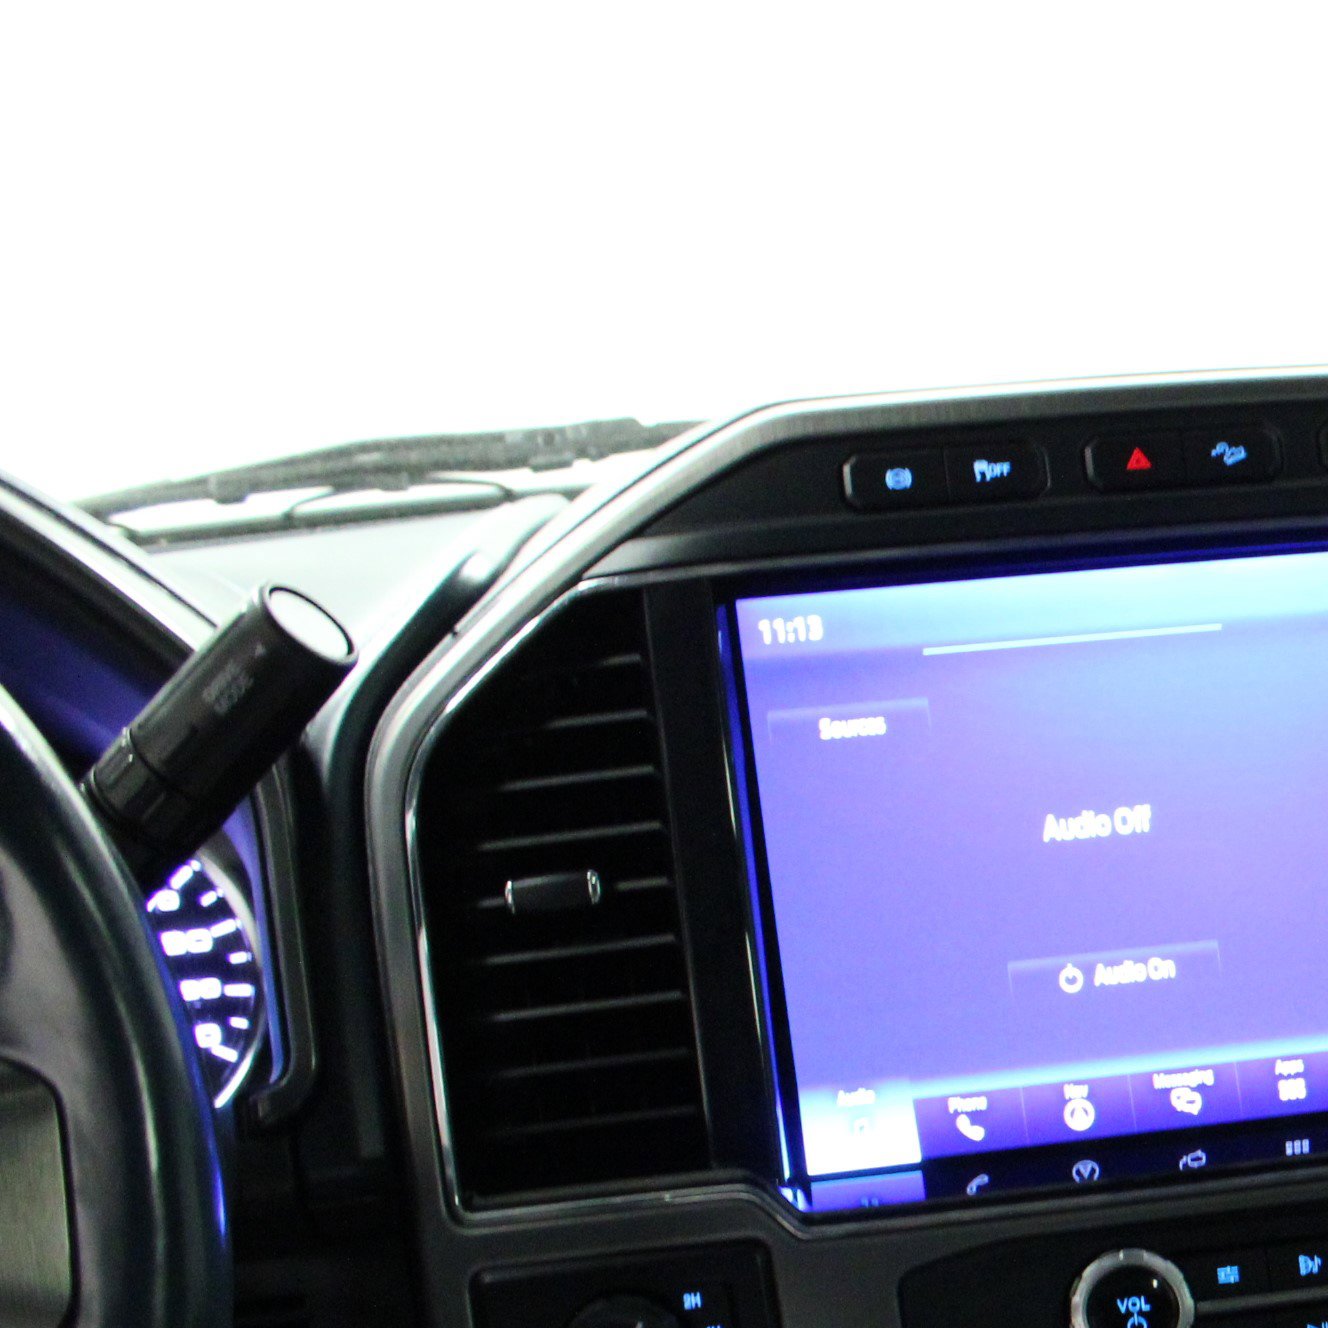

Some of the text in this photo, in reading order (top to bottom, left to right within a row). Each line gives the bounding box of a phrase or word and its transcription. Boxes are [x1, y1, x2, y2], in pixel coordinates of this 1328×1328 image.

[988, 461, 1011, 479] OFF
[758, 615, 824, 644] 11:13
[818, 717, 887, 740] Sources
[1043, 804, 1151, 842] Audio Off
[1094, 956, 1176, 987] Audio On
[947, 1096, 988, 1114] Phone
[683, 1291, 702, 1310] 2H
[1116, 1296, 1151, 1315] VOL
